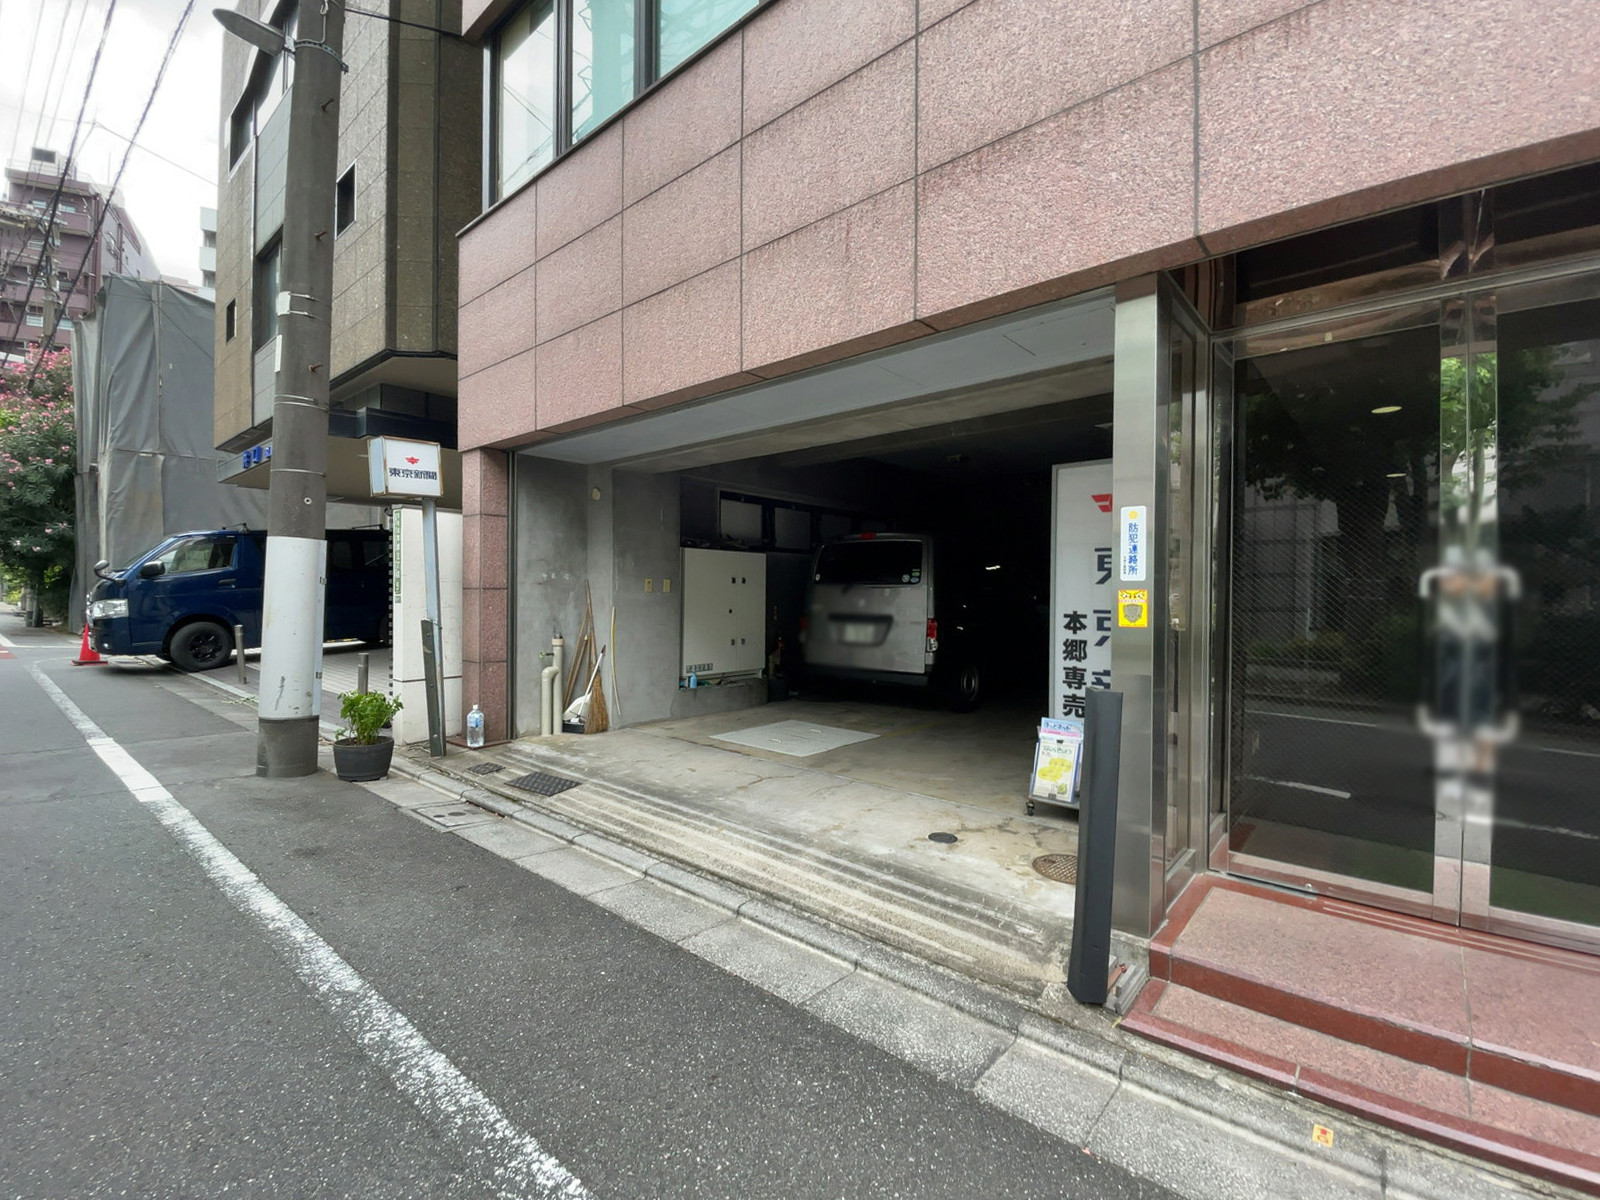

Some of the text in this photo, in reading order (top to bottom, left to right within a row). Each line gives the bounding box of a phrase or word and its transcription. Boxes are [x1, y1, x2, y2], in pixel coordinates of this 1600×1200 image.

[388, 467, 438, 481] 東京新聞
[1127, 522, 1139, 576] 防犯連絡所
